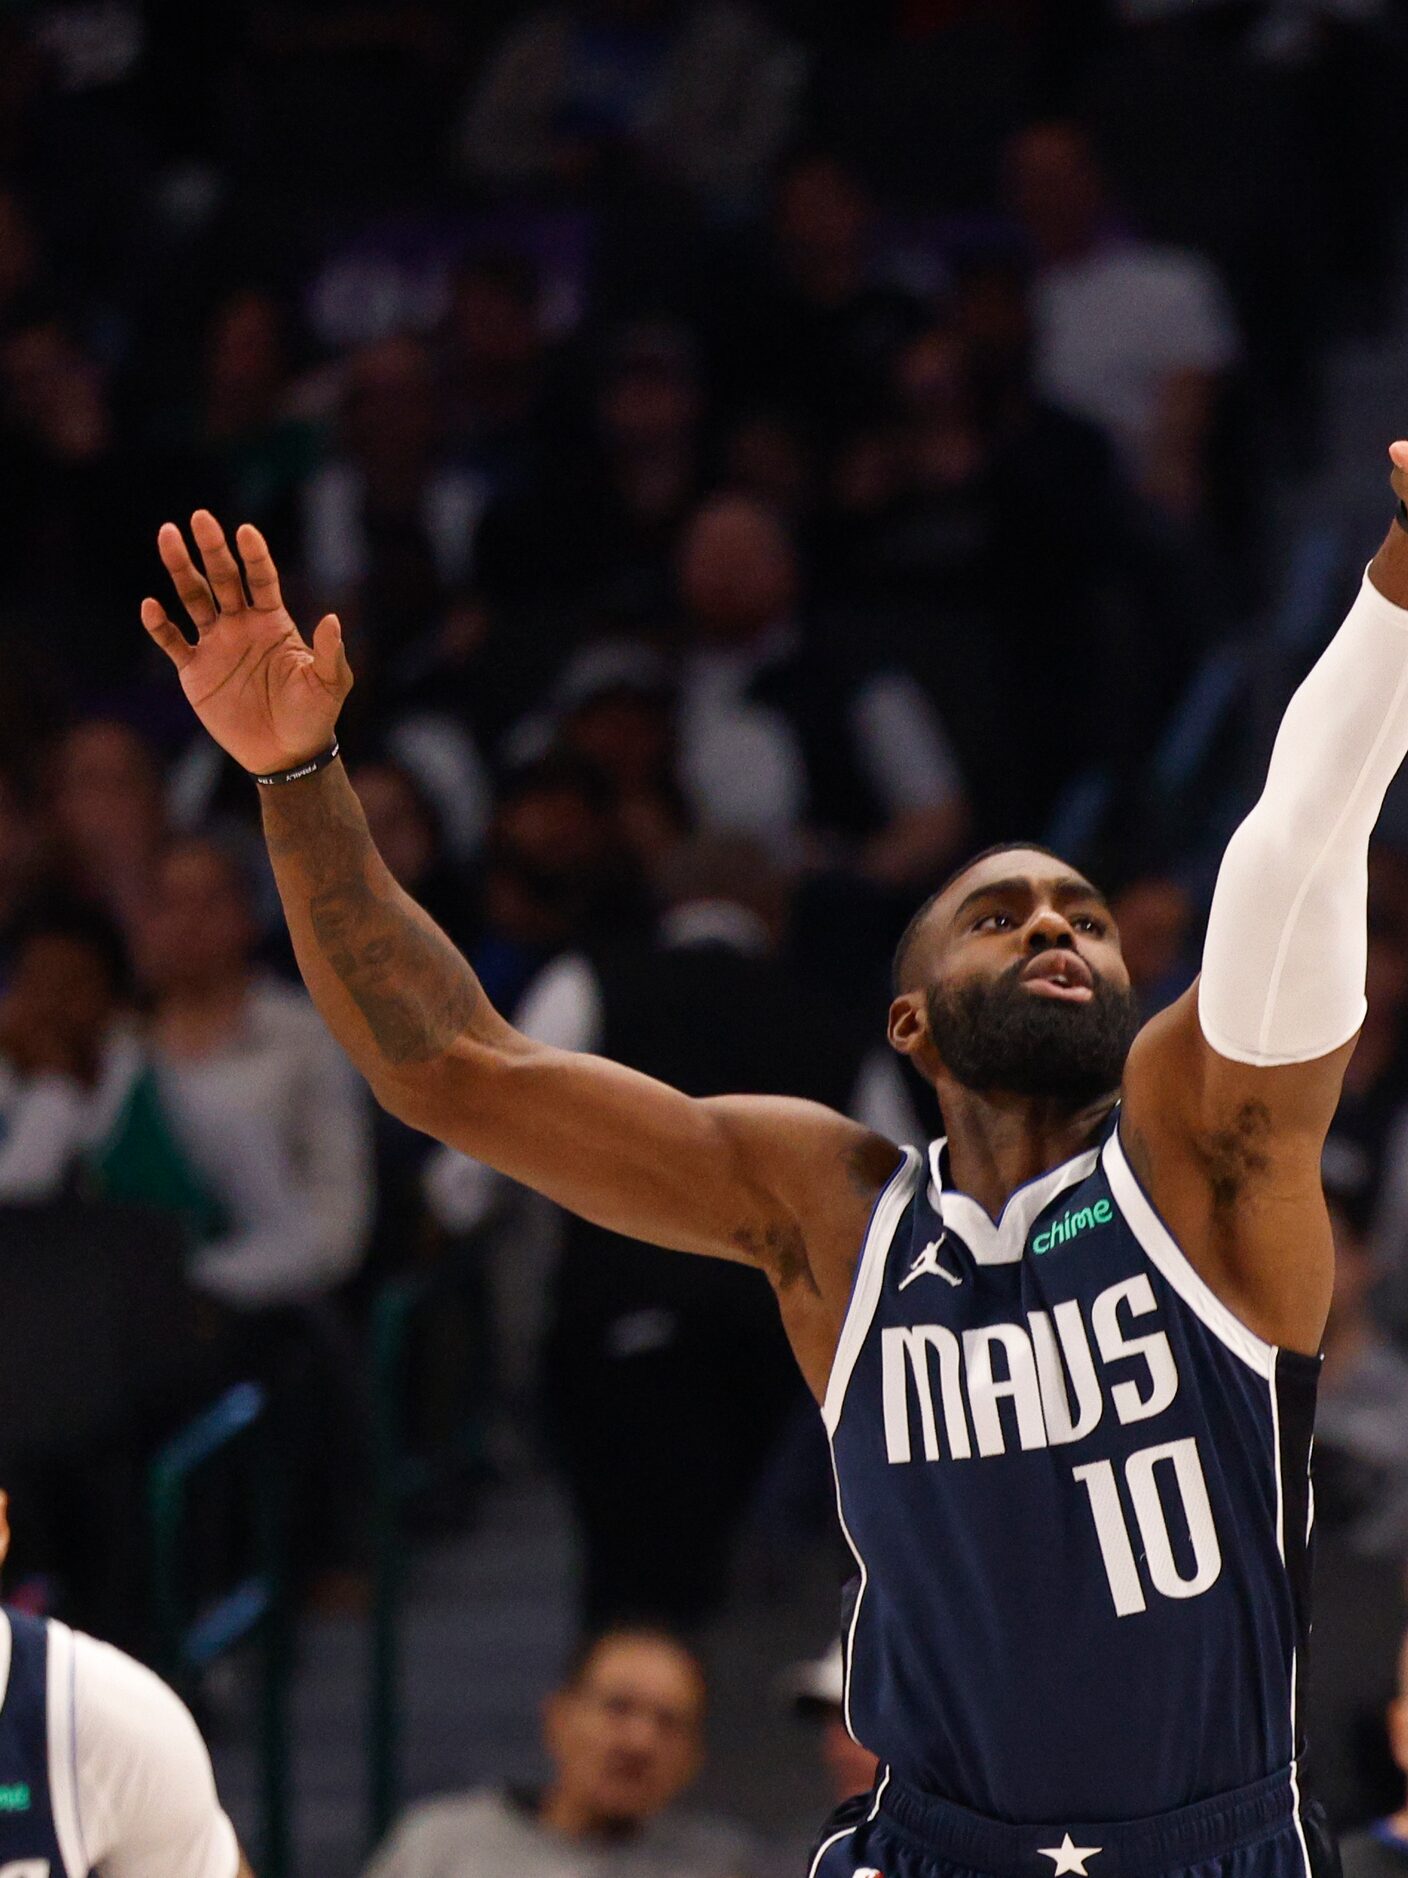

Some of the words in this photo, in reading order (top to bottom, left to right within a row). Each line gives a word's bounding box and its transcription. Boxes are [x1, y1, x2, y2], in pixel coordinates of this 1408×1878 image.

[1032, 1198, 1113, 1254] chime
[881, 1273, 1179, 1464] MAVS
[1072, 1437, 1222, 1618] 10
